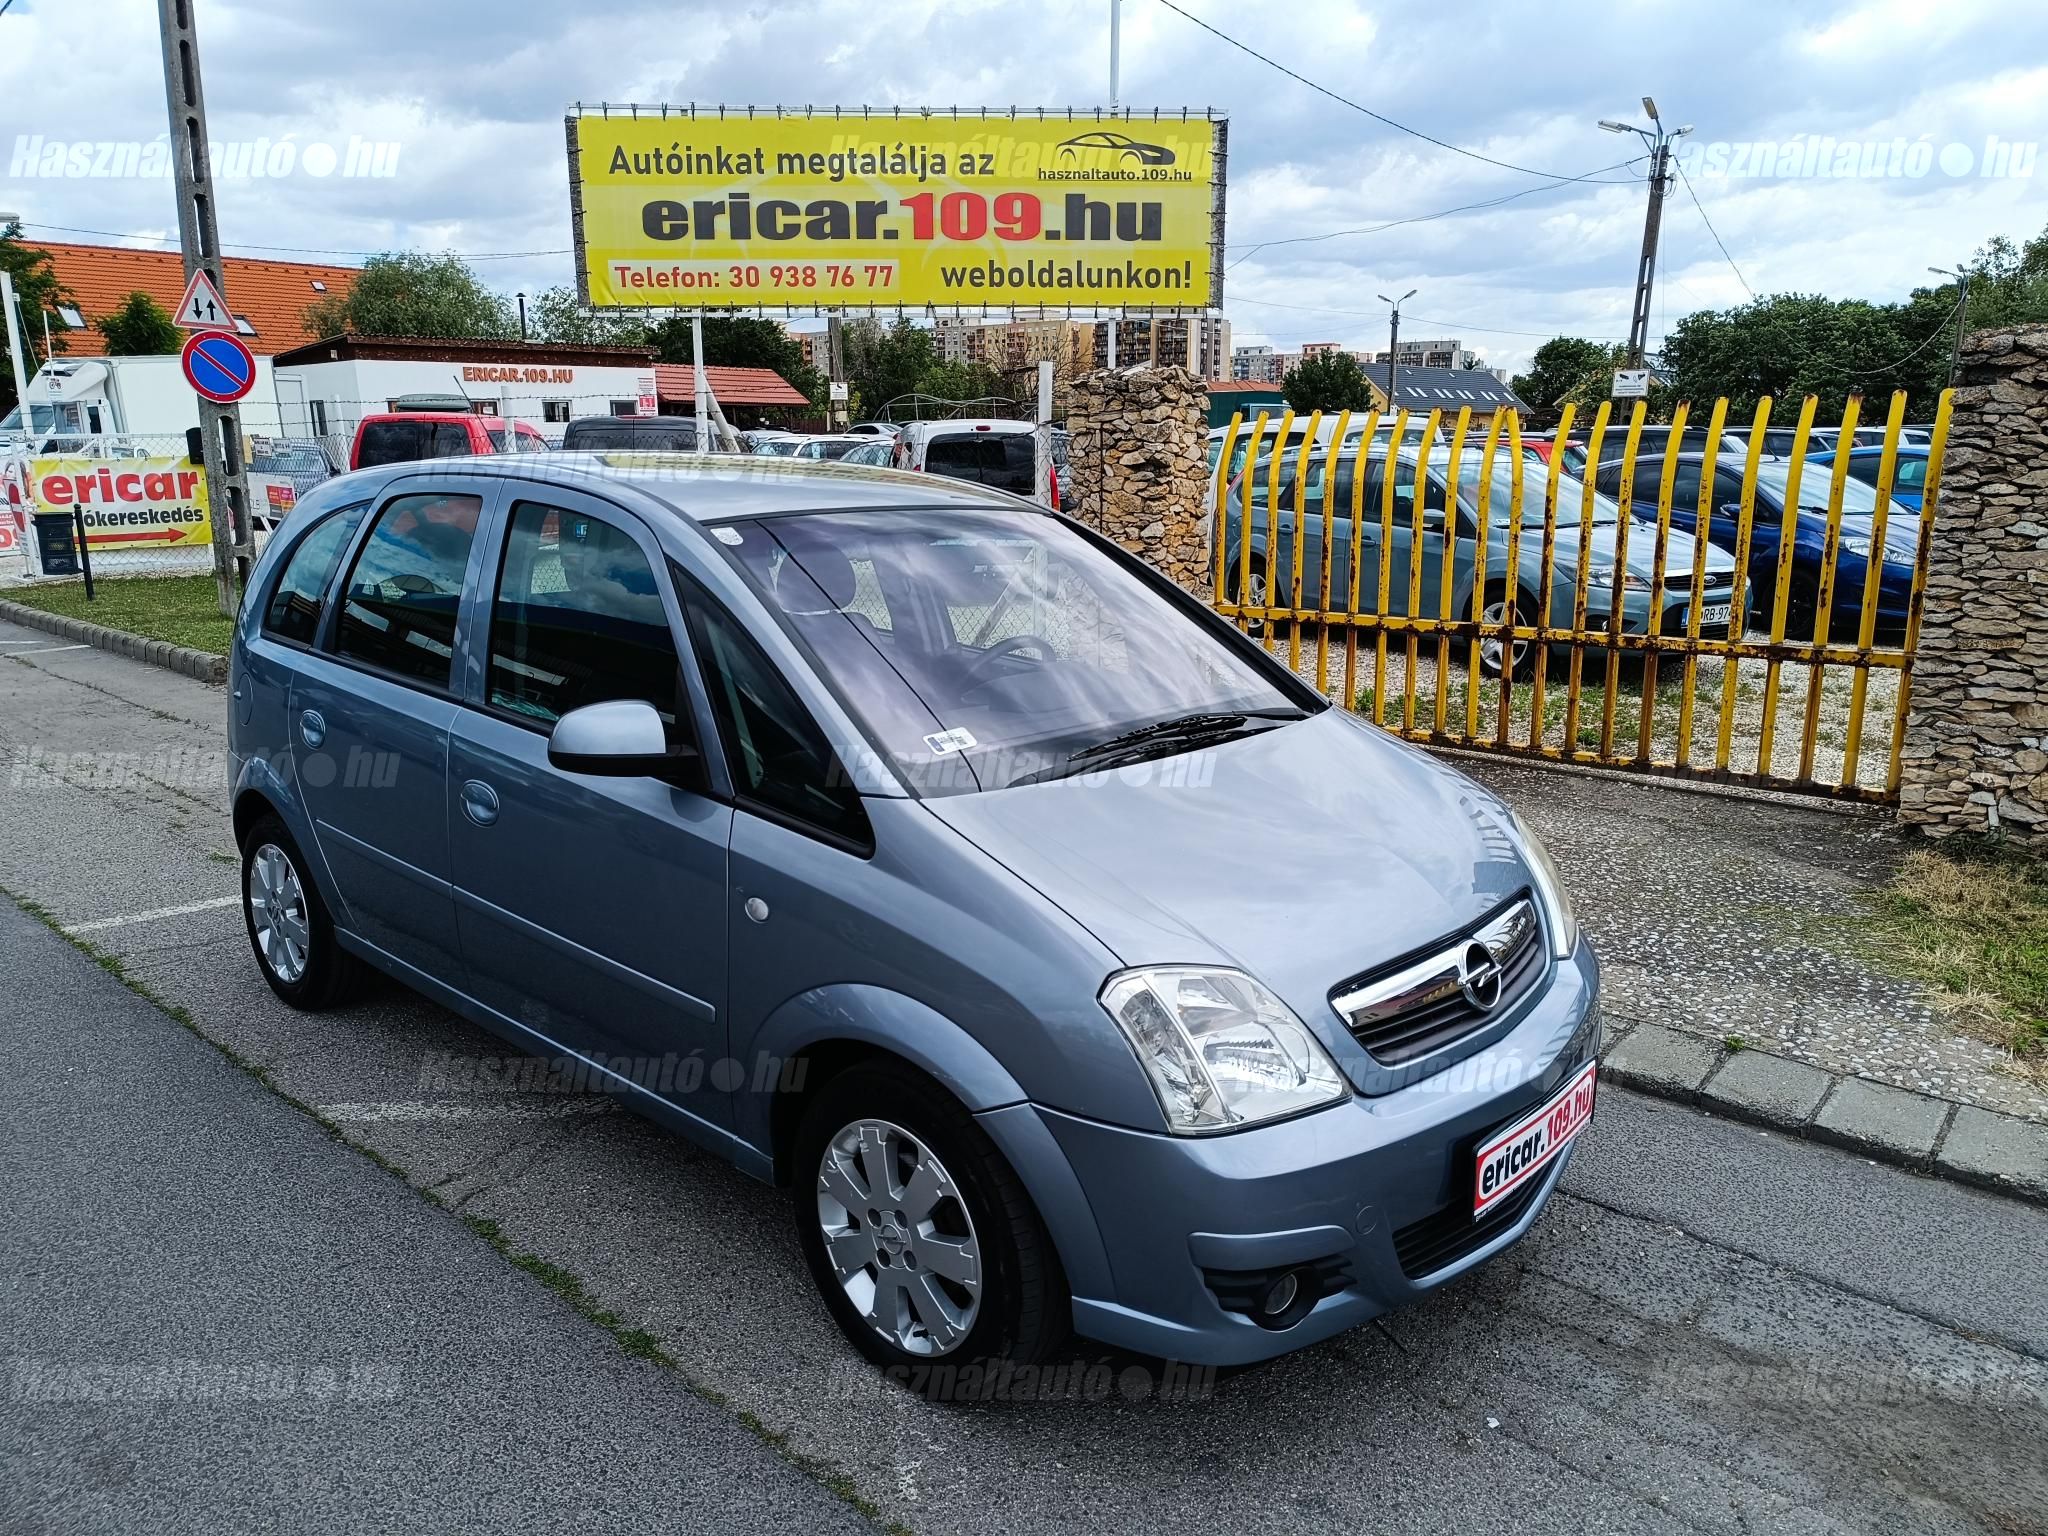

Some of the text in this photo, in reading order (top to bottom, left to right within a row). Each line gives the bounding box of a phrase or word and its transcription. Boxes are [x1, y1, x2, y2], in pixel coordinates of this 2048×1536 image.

[608, 141, 994, 183] Autóinkat megtalálja az
[1038, 168, 1193, 182] hasznaltauto.109.hu
[641, 191, 1163, 242] ericar.109.hu
[614, 265, 894, 289] Telefon: 30 938 76 77
[941, 259, 1192, 289] weboldalunkon!
[462, 366, 574, 384] ERICAR.109.HU
[41, 467, 199, 505] ericar
[1701, 605, 1731, 622] RB-97
[1482, 1081, 1592, 1195] ericar.109.hu
